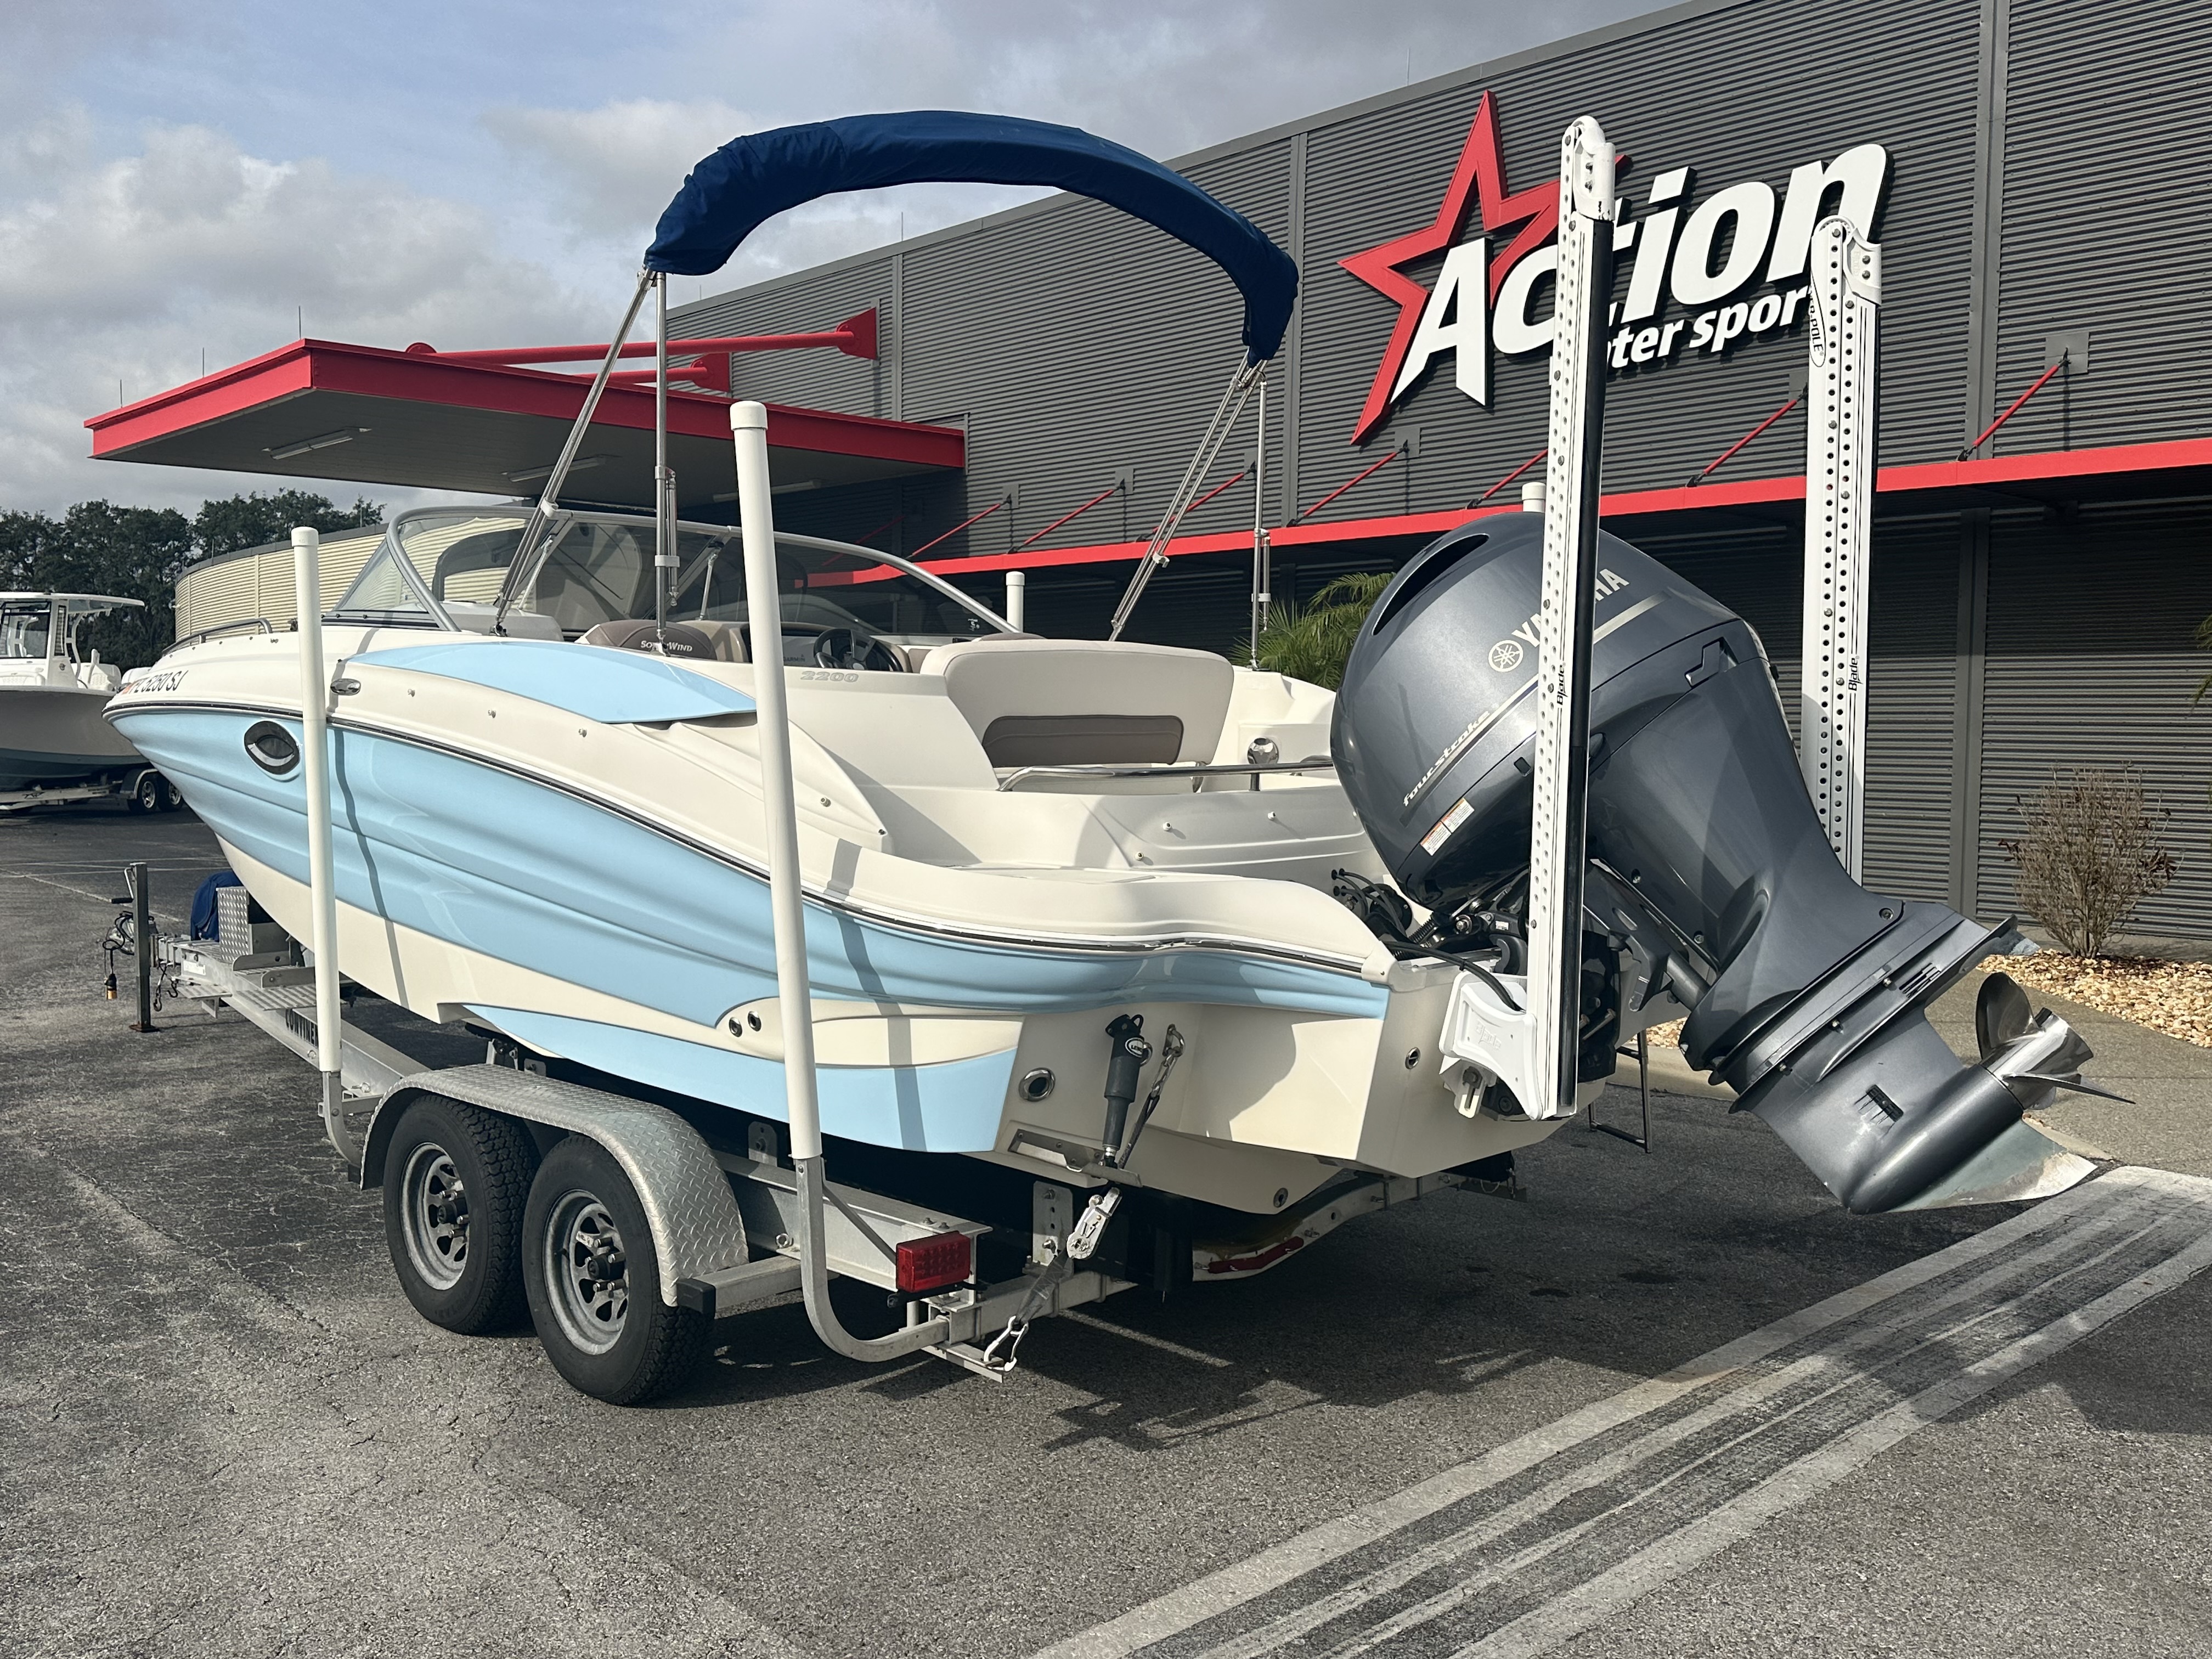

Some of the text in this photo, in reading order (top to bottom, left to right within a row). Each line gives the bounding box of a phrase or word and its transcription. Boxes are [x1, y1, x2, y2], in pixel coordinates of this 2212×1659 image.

[1689, 286, 1810, 352] spor
[1511, 568, 1630, 647] YHA
[640, 640, 693, 652] SOWIND
[166, 670, 189, 691] SJ
[800, 670, 859, 682] 2200
[1557, 664, 1568, 705] Blade
[1848, 658, 1863, 691] Blade
